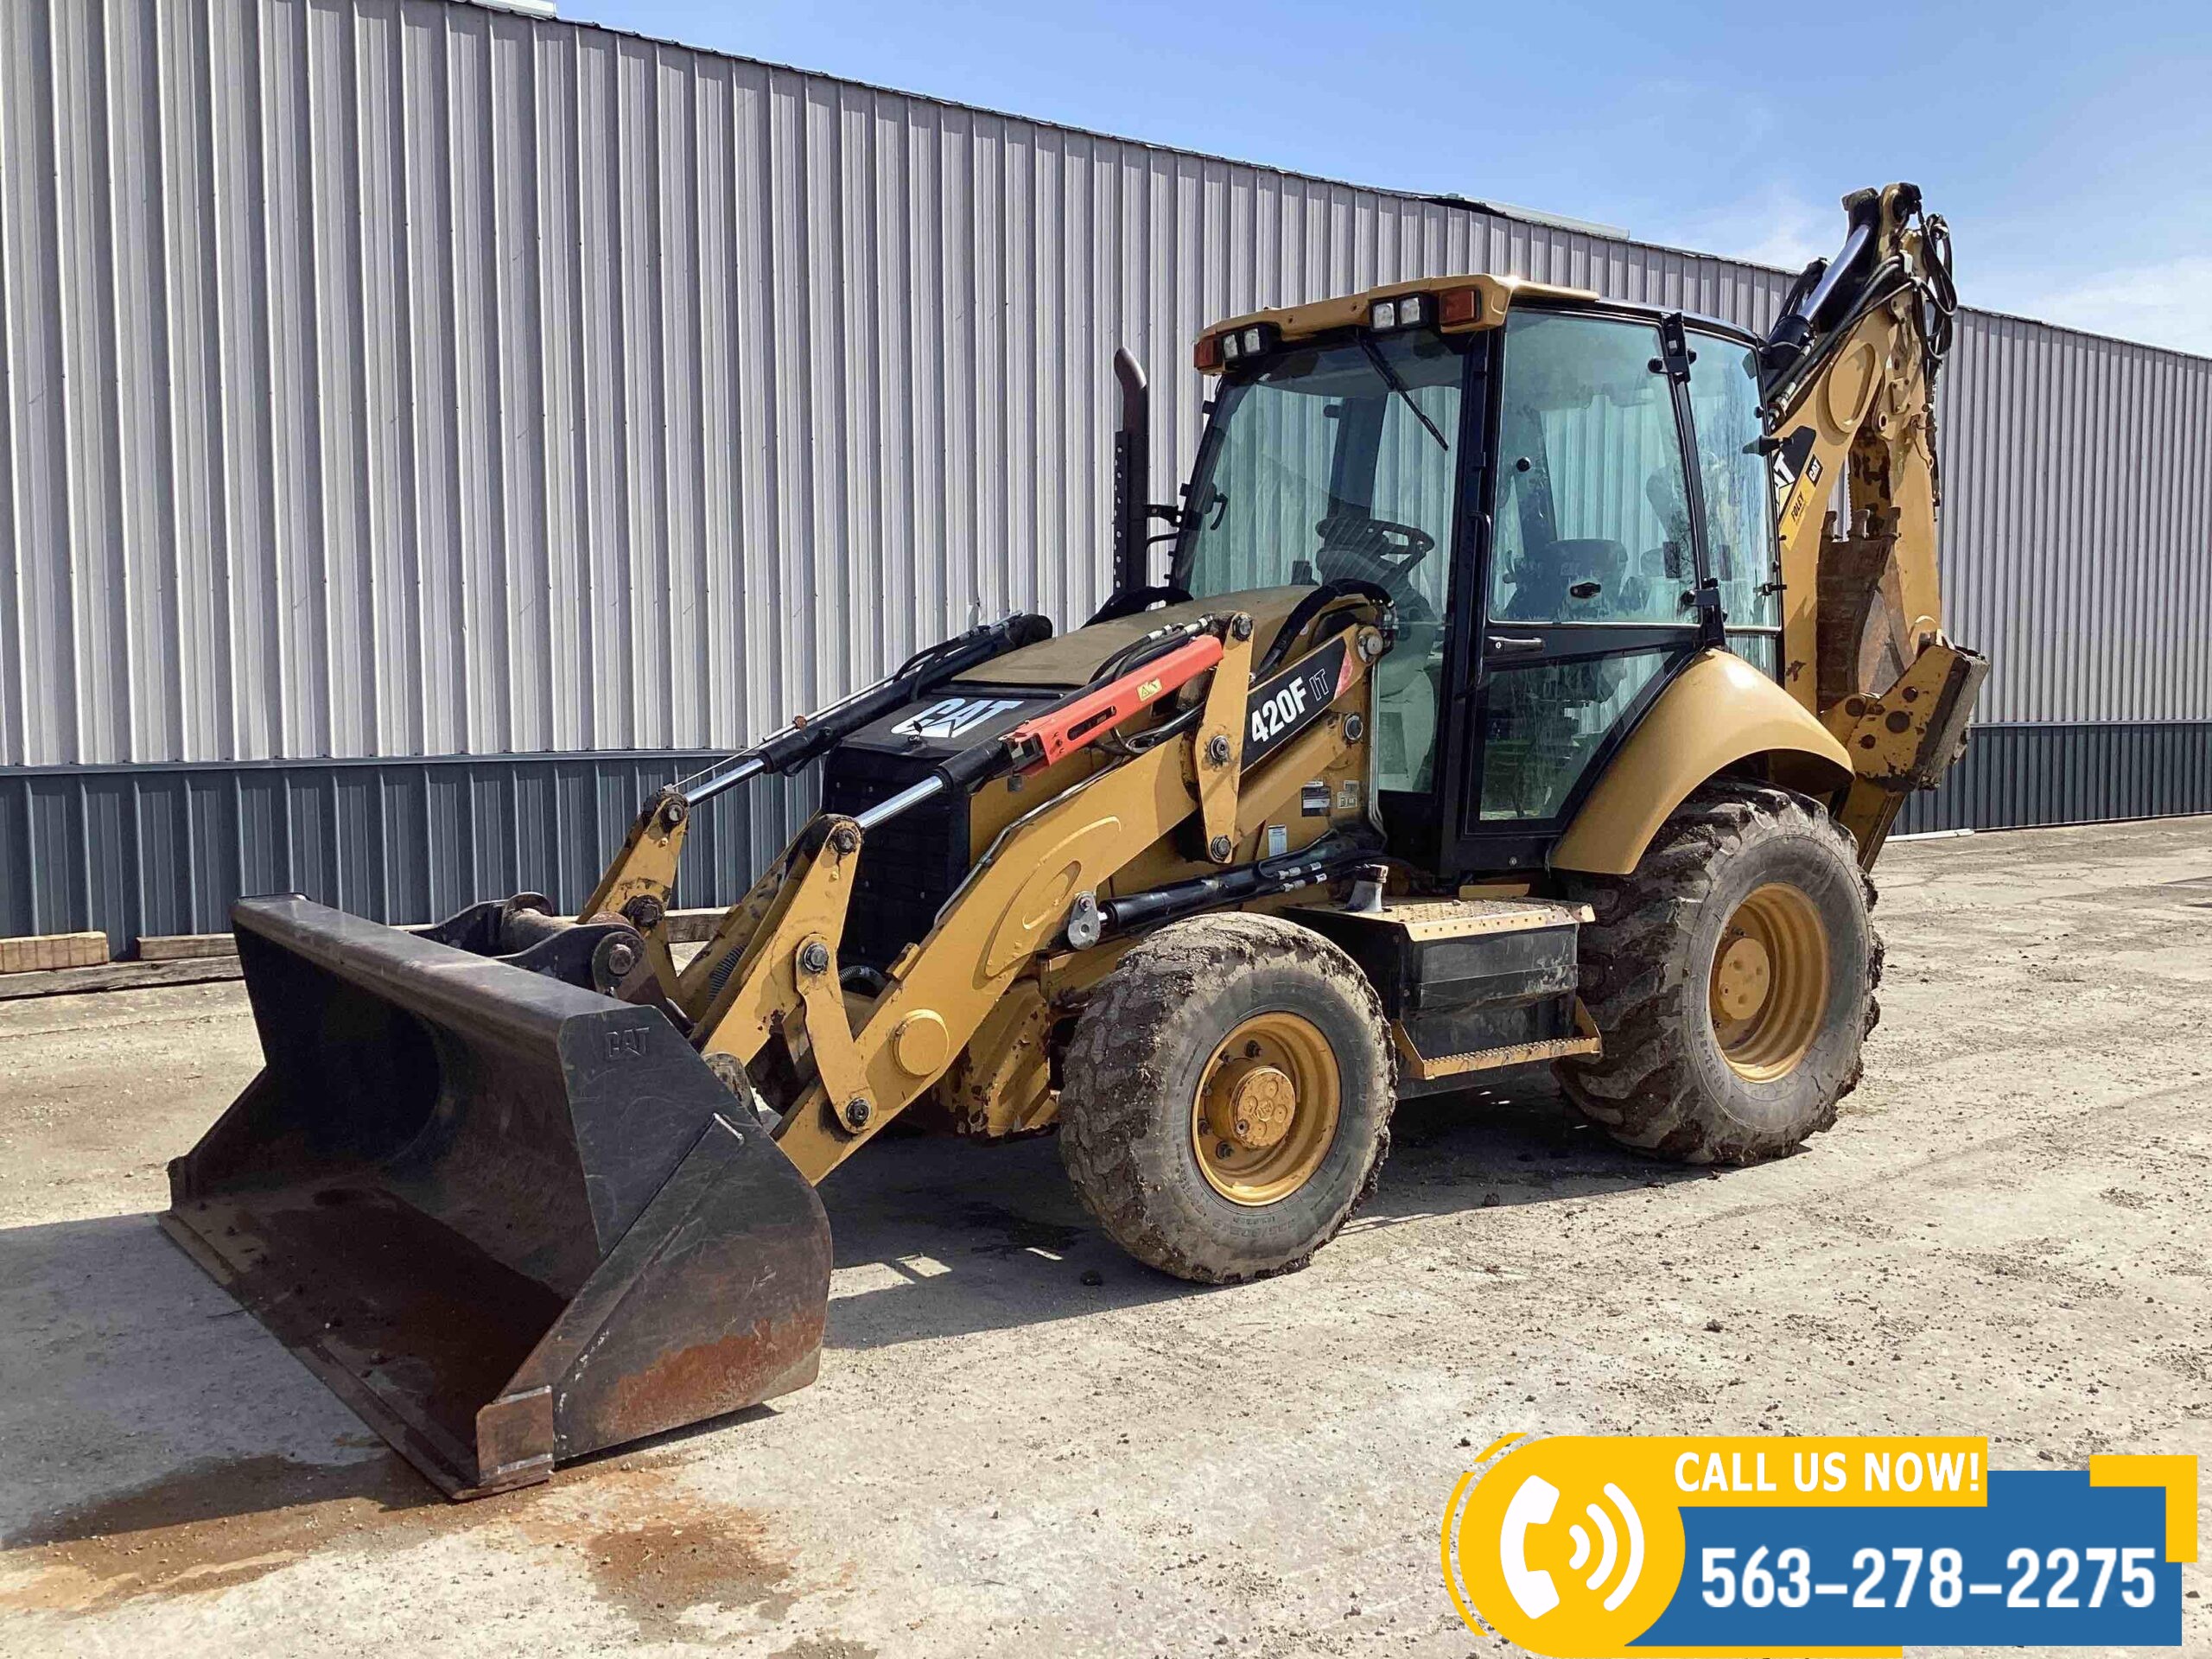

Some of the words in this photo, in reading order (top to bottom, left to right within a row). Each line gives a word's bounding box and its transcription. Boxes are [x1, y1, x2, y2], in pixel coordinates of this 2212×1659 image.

[890, 697, 1025, 739] CAT
[1251, 676, 1307, 742] 420F
[1308, 668, 1330, 702] IT
[606, 1027, 650, 1058] CAT
